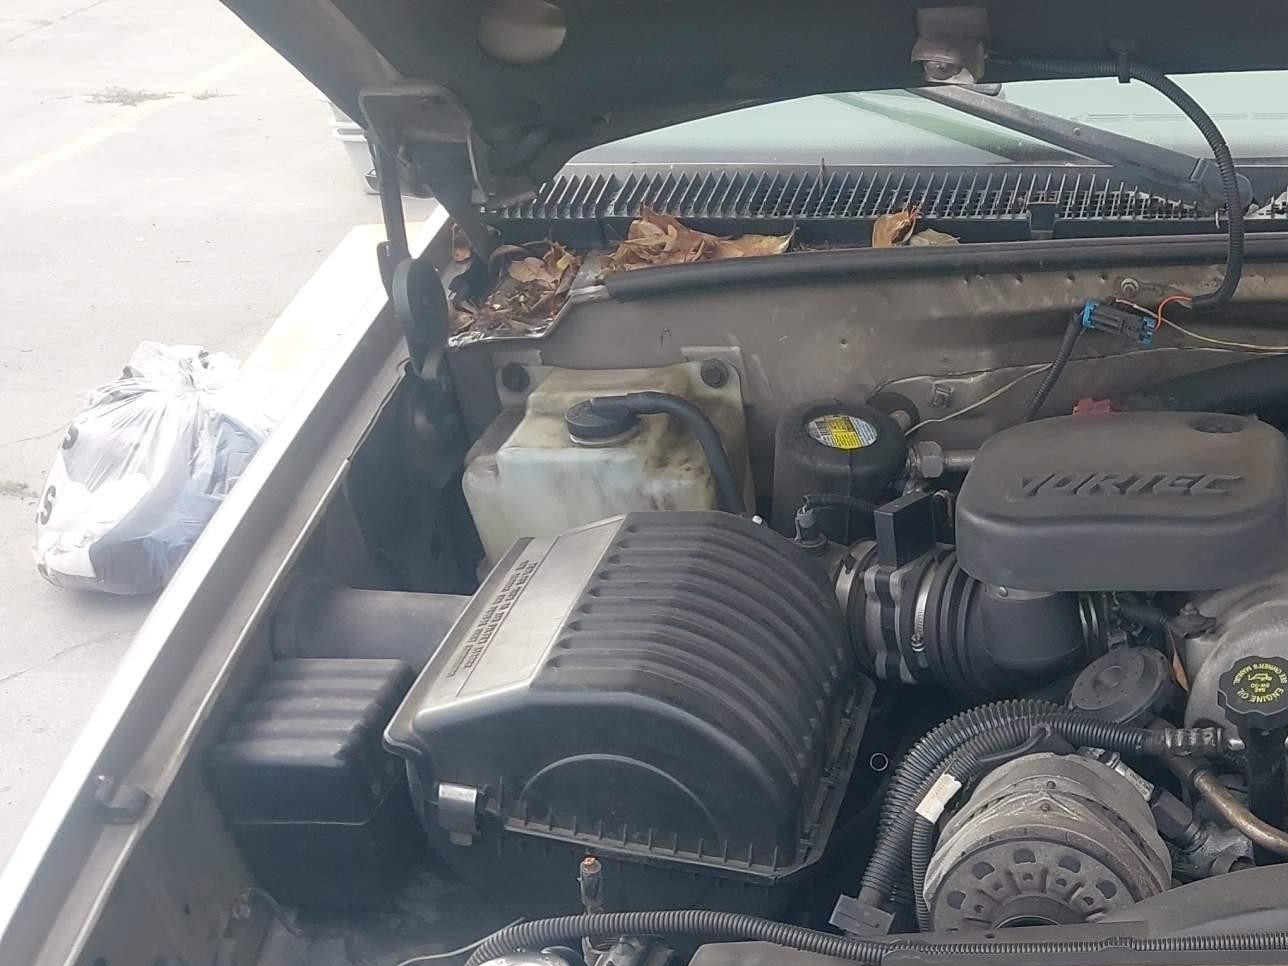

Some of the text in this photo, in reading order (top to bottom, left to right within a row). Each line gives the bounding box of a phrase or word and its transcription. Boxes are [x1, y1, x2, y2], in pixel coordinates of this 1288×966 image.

[1018, 470, 1245, 498] VORTEC
[1236, 687, 1284, 702] ENGINE OIL
